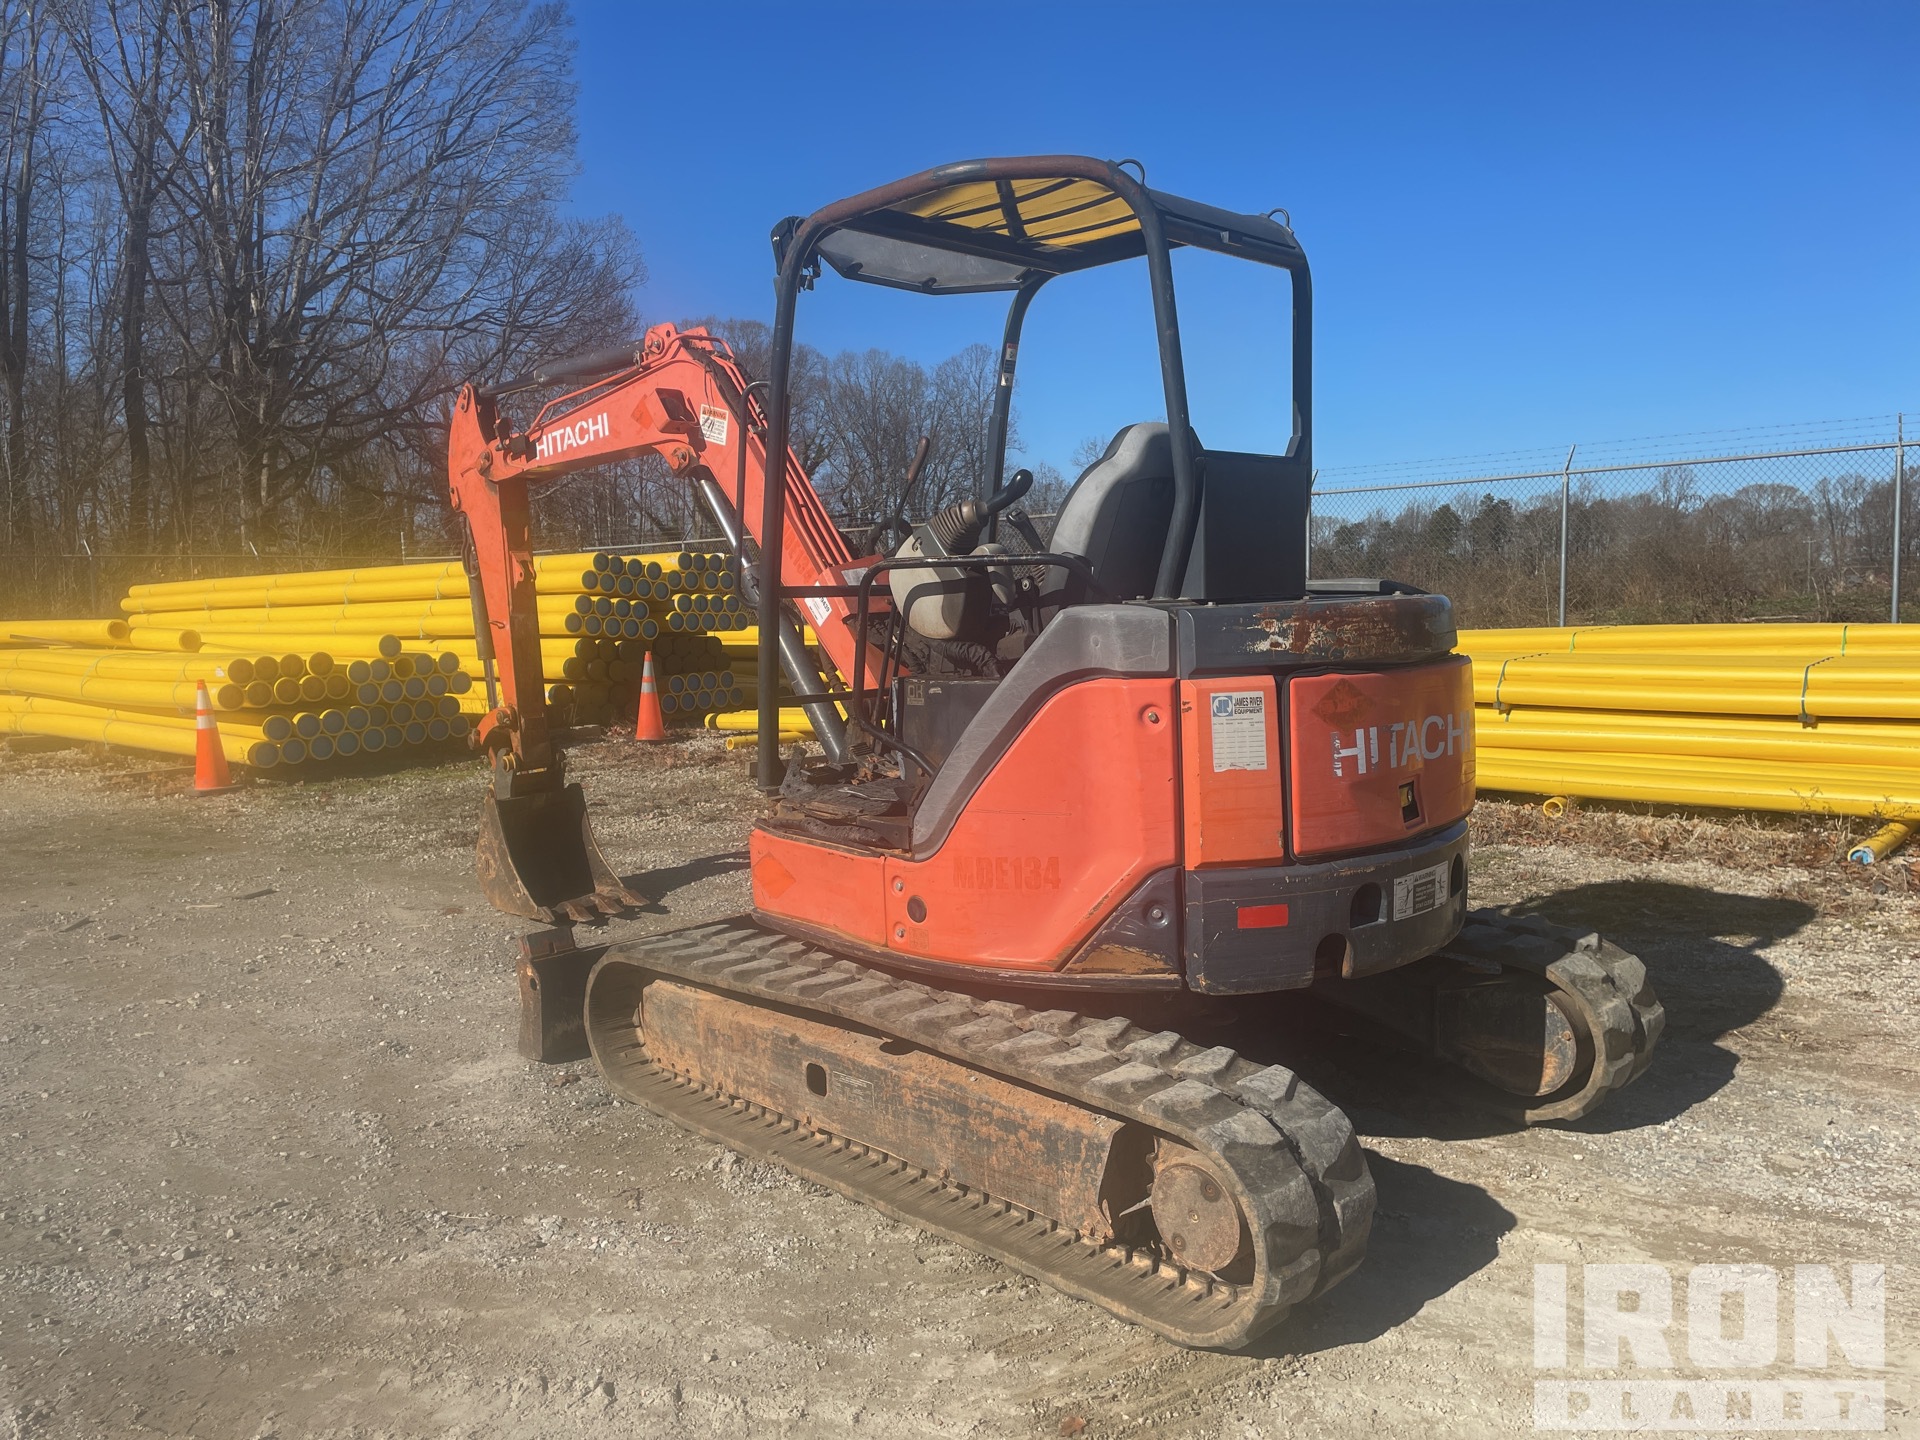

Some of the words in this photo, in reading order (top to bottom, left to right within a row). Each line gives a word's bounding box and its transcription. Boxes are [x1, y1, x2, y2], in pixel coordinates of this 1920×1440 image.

[535, 412, 610, 460] HITACHI
[1234, 697, 1248, 707] JAMES
[1249, 696, 1263, 706] RIVER
[1234, 707, 1263, 715] EQUIPMENT
[1330, 710, 1471, 778] HITACHI
